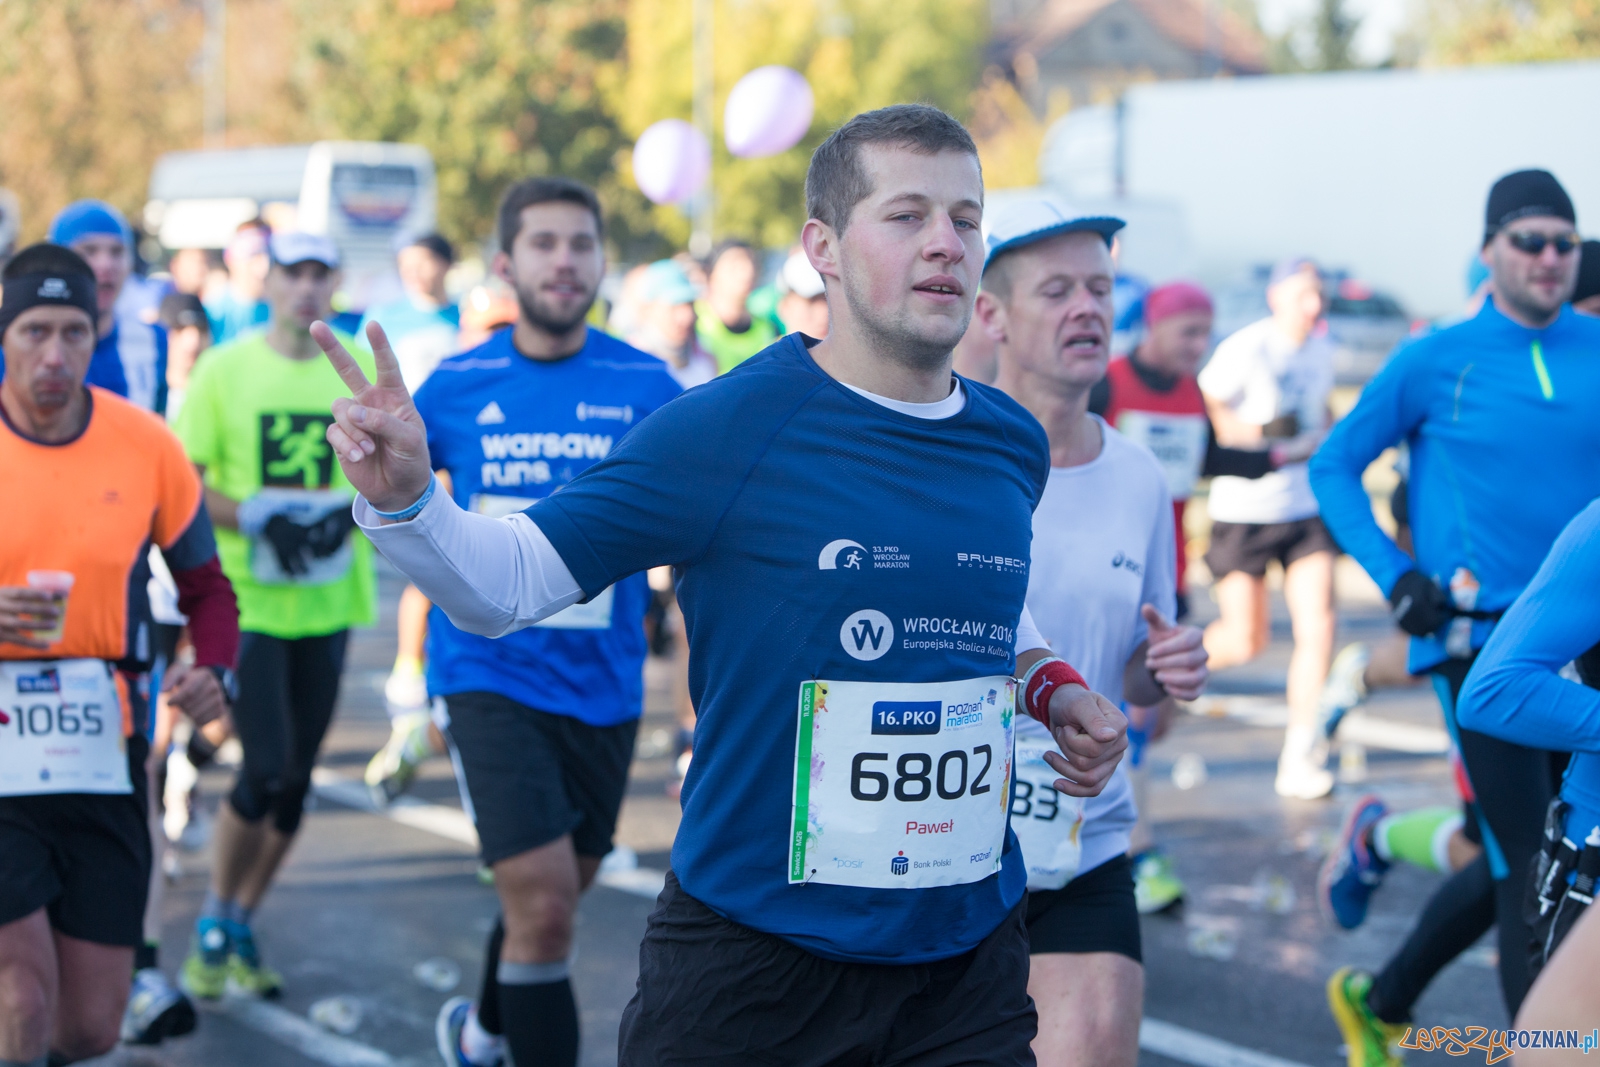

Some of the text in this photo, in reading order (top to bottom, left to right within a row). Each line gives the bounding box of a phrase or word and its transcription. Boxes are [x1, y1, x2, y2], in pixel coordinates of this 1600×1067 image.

[480, 432, 613, 460] warsaw
[903, 618, 1013, 644] WROCŁAW 2016
[903, 639, 1011, 661] Europejska Stolica Kultury
[803, 687, 812, 718] 11.10.2015
[12, 703, 104, 736] 1065
[946, 712, 983, 727] maraton
[850, 743, 992, 802] 6802
[795, 830, 804, 847] M26
[905, 819, 955, 835] Paweł
[913, 861, 931, 869] Bank
[932, 858, 952, 868] Polski
